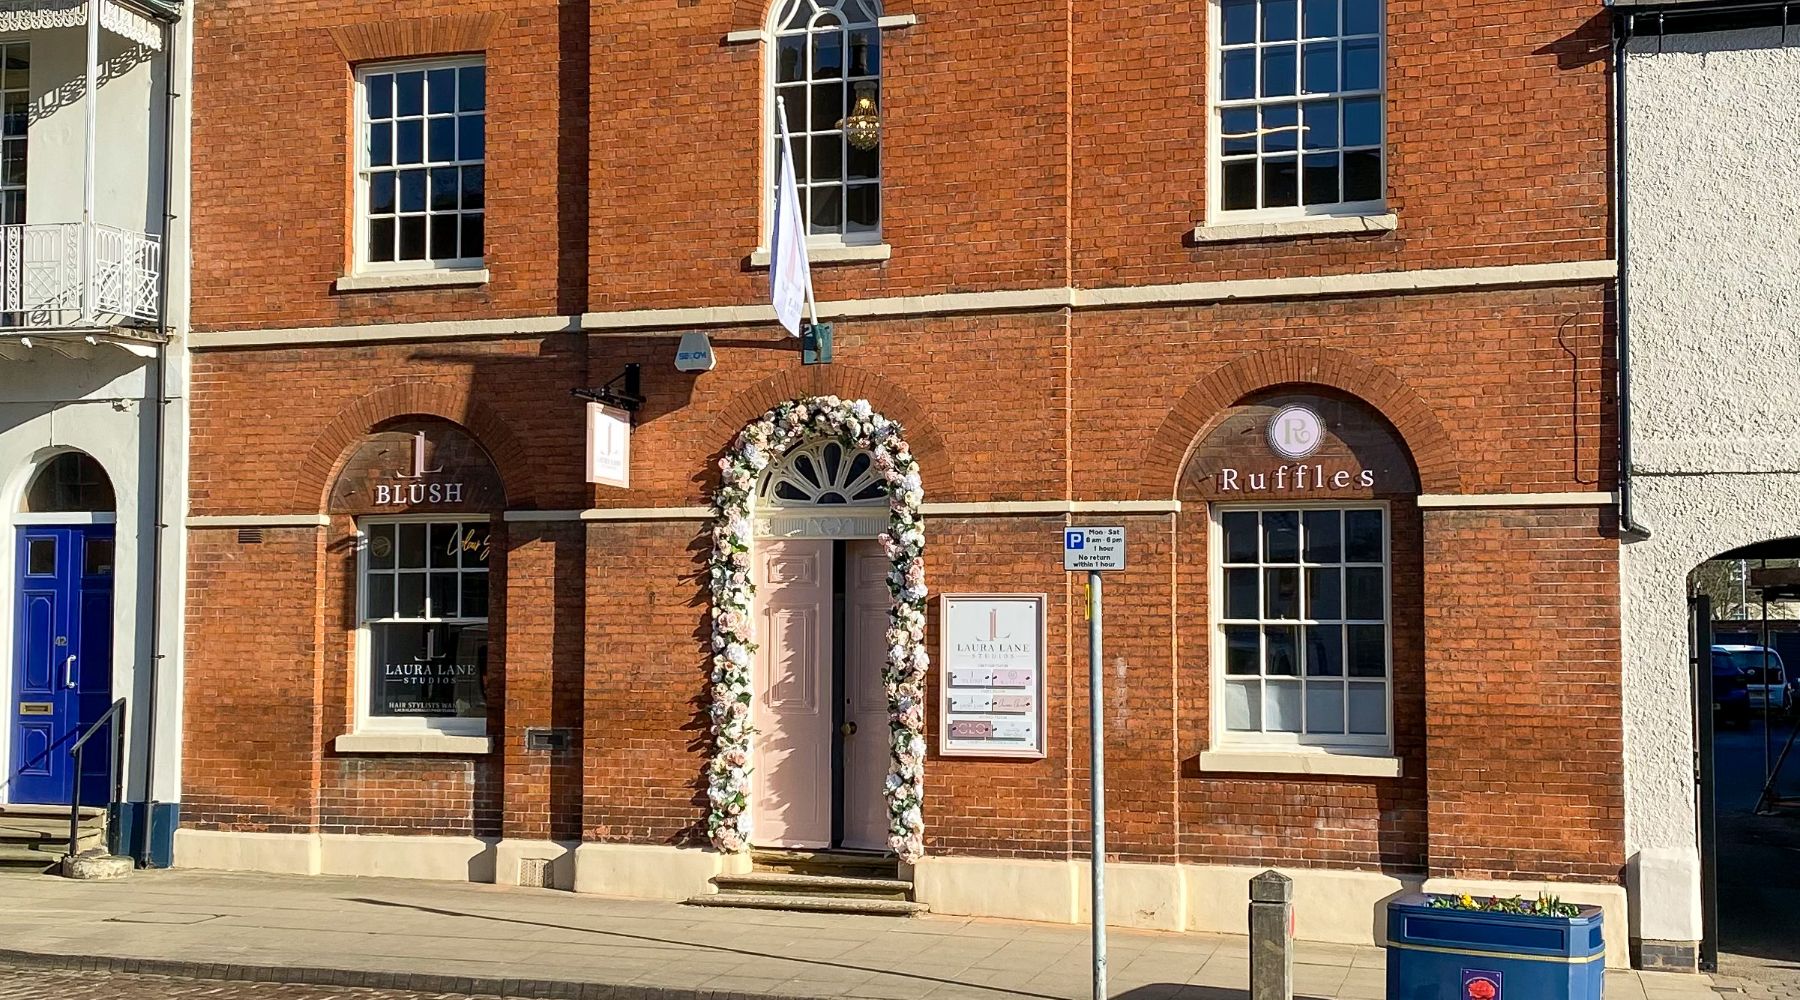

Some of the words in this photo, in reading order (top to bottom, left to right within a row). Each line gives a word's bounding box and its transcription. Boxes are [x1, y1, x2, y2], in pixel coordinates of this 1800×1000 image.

[1284, 418, 1311, 445] R
[1222, 464, 1374, 491] Ruffles
[376, 483, 463, 504] BLUSH
[1070, 533, 1081, 548] P
[957, 643, 995, 652] LAURA
[1000, 643, 1030, 652] LANE
[385, 664, 432, 675] LAURA
[438, 664, 476, 675] LANE
